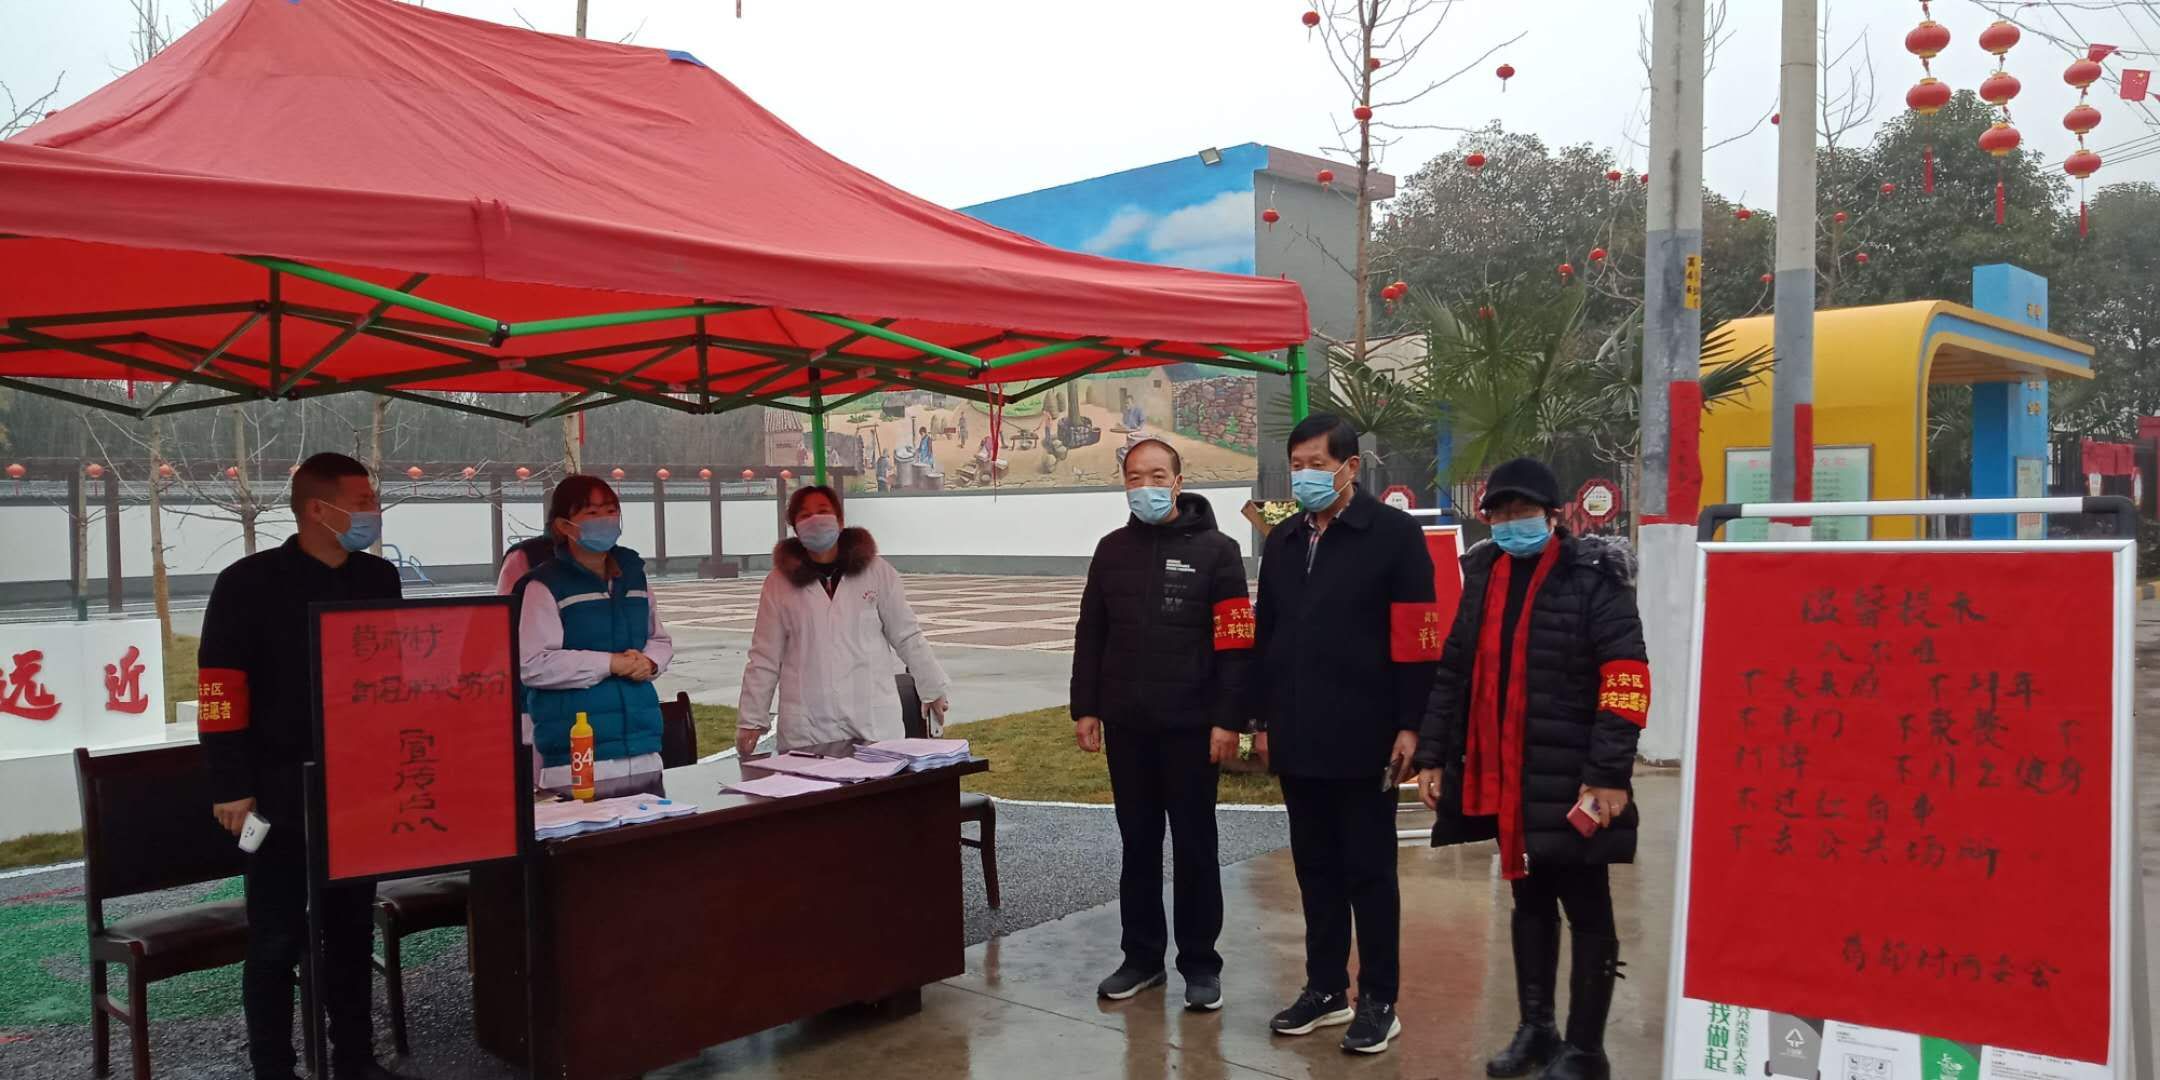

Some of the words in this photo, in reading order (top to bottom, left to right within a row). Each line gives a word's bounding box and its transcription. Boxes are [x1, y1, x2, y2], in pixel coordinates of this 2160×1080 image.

[104, 645, 149, 714] 近
[1606, 673, 1644, 688] 长安区
[572, 747, 594, 772] 84
